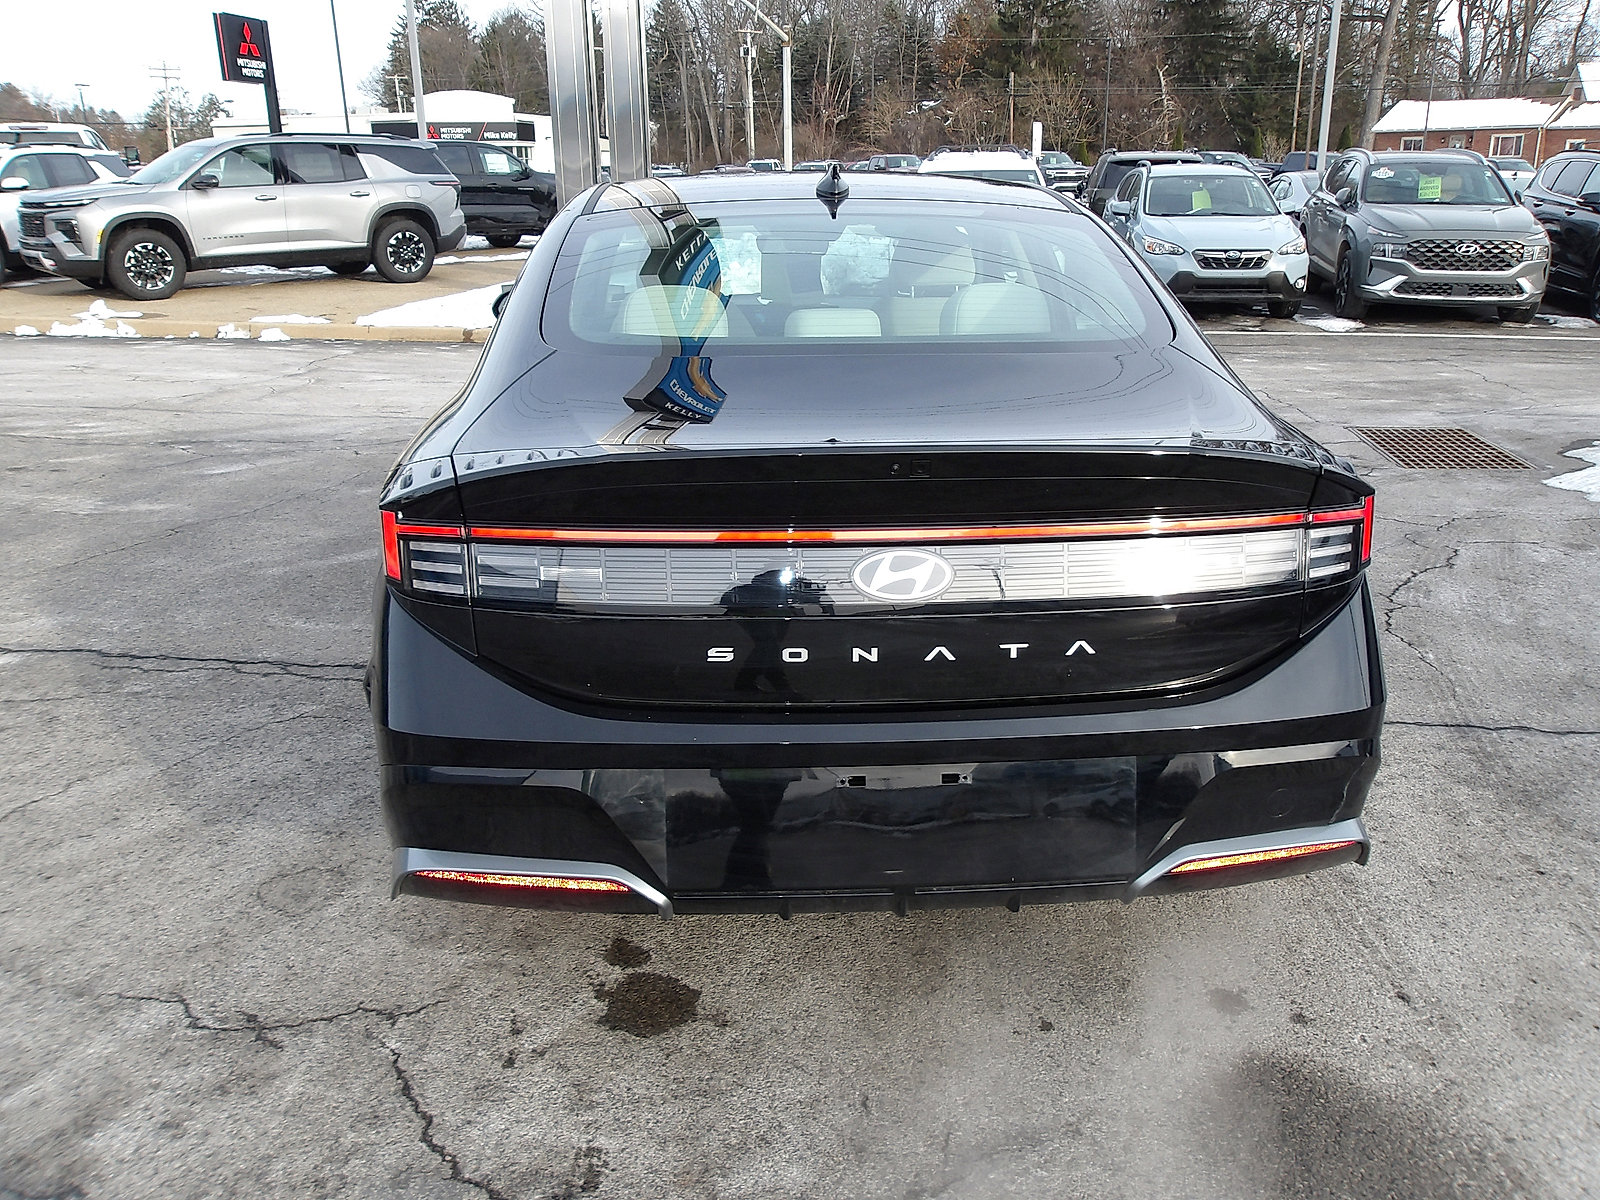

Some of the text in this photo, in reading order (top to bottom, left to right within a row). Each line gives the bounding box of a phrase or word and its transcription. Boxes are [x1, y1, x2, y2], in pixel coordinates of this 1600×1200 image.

[236, 57, 267, 70] MITSUBISHI
[241, 67, 265, 79] MOTORS
[483, 131, 517, 140] Mike Kelly
[669, 378, 717, 414] CHEVROLET
[664, 402, 702, 419] KELLY
[706, 640, 1096, 663] SONATA
